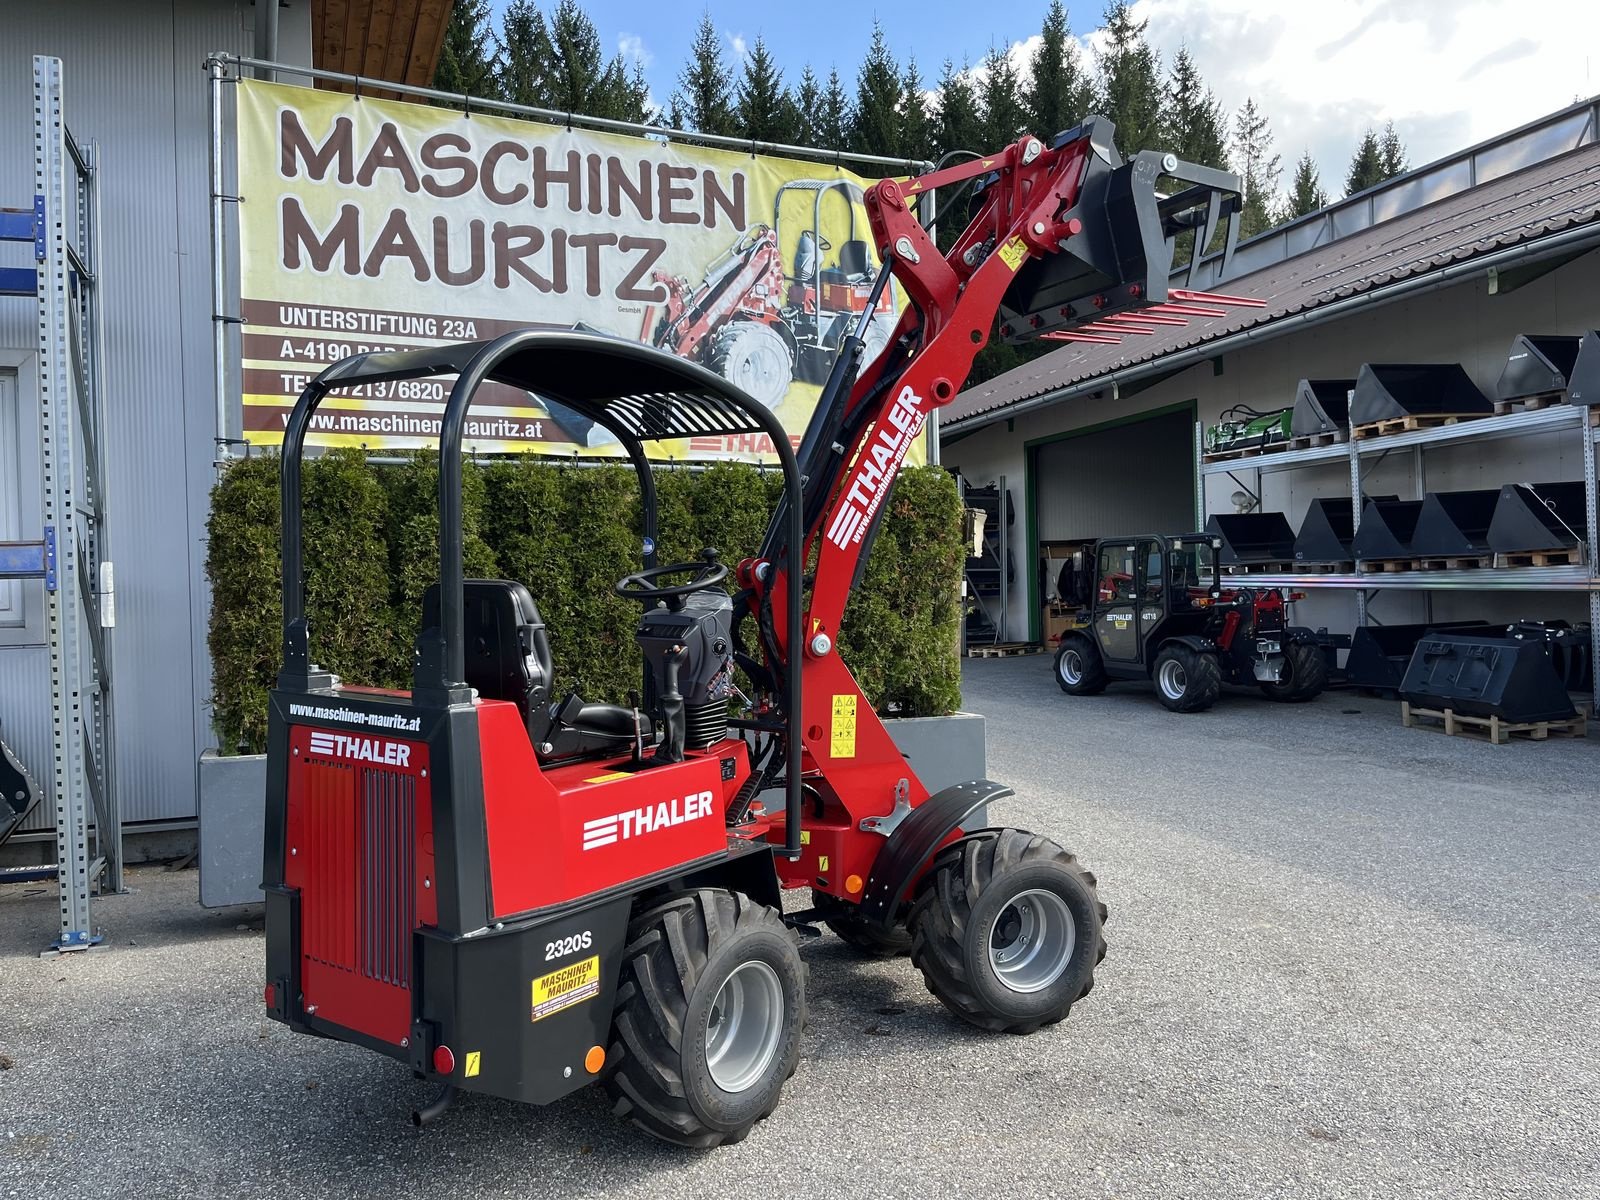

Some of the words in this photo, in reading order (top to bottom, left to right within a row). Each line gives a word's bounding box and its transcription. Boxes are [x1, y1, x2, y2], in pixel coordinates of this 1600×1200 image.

[280, 109, 746, 232] MASCHINEN
[282, 197, 668, 303] MAURITZ
[279, 306, 437, 336] UNTERSTIFTUNG
[442, 319, 478, 339] 23A
[279, 339, 352, 361] A-4190
[847, 384, 923, 507] THALER
[852, 410, 924, 544] www.maschinen-mauritz.at
[1113, 613, 1133, 621] THALER
[289, 703, 421, 732] www.maschinen-mauritz.at
[334, 735, 411, 768] THALER
[618, 790, 713, 840] THALER
[545, 930, 592, 961] 2320S
[541, 960, 593, 990] MASCHINEN
[547, 974, 587, 999] MAURITZ
